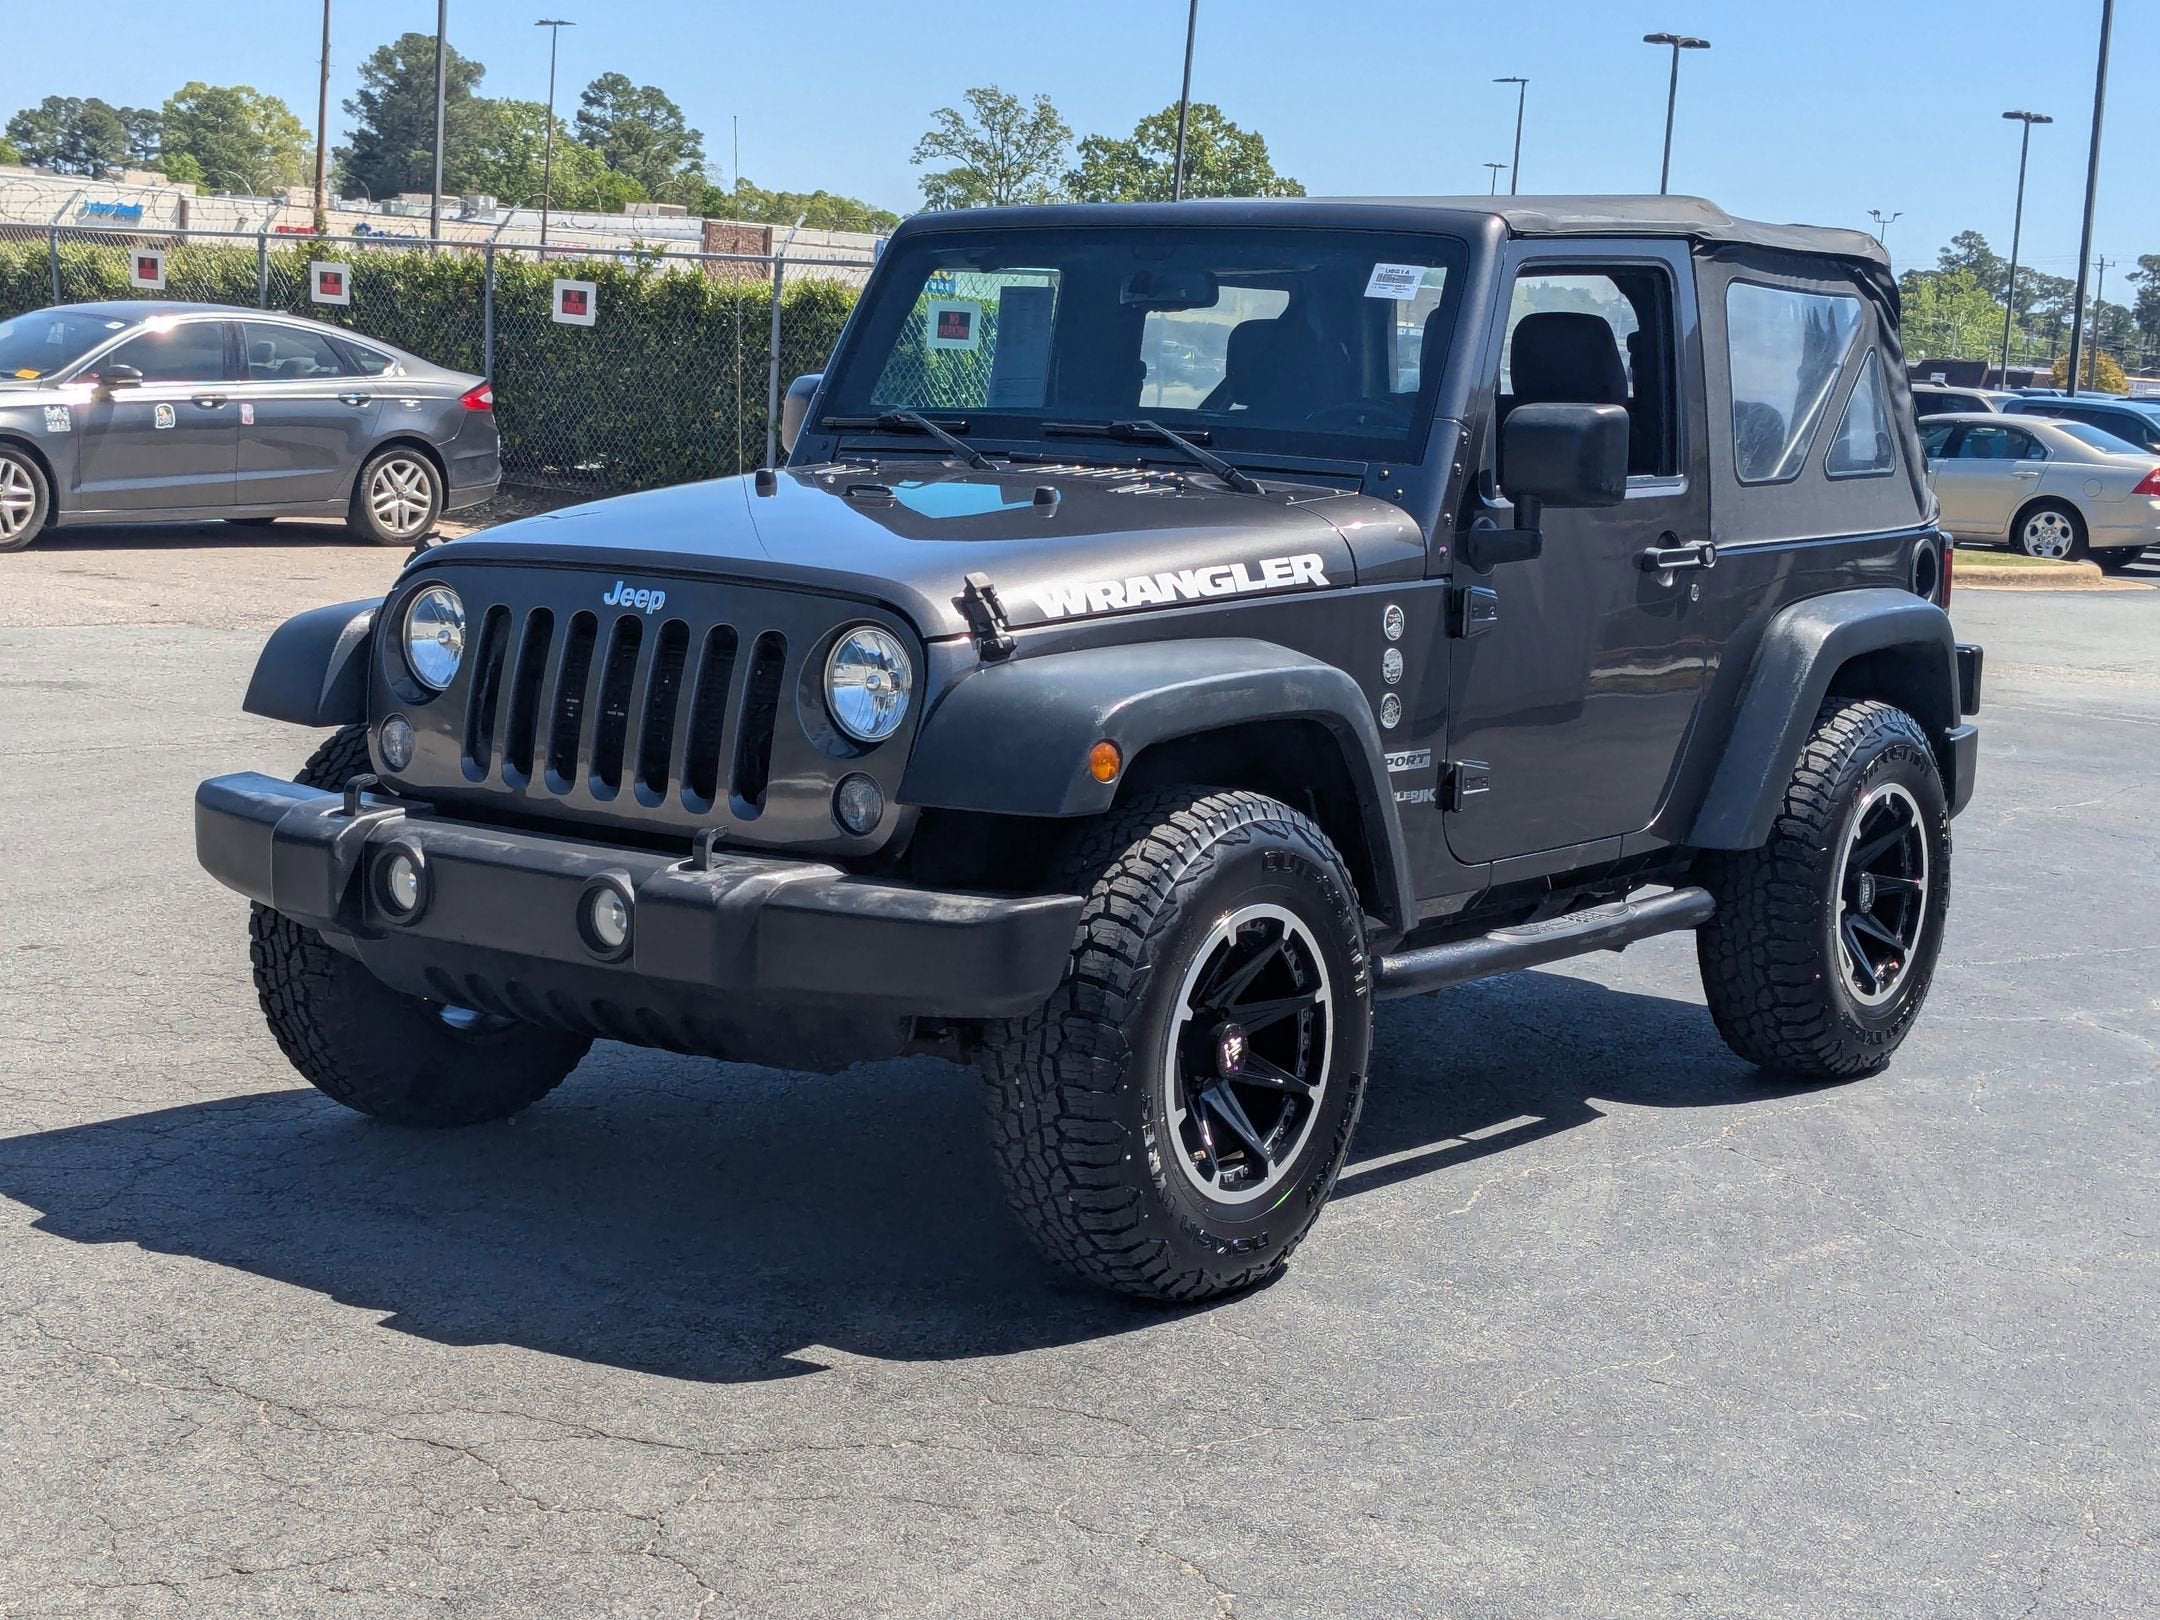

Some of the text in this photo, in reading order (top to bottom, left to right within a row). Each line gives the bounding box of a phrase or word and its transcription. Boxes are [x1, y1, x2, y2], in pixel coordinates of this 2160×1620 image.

[603, 580, 666, 615] Jeep
[1033, 553, 1331, 619] WRANGLER
[1386, 753, 1427, 767] PORT
